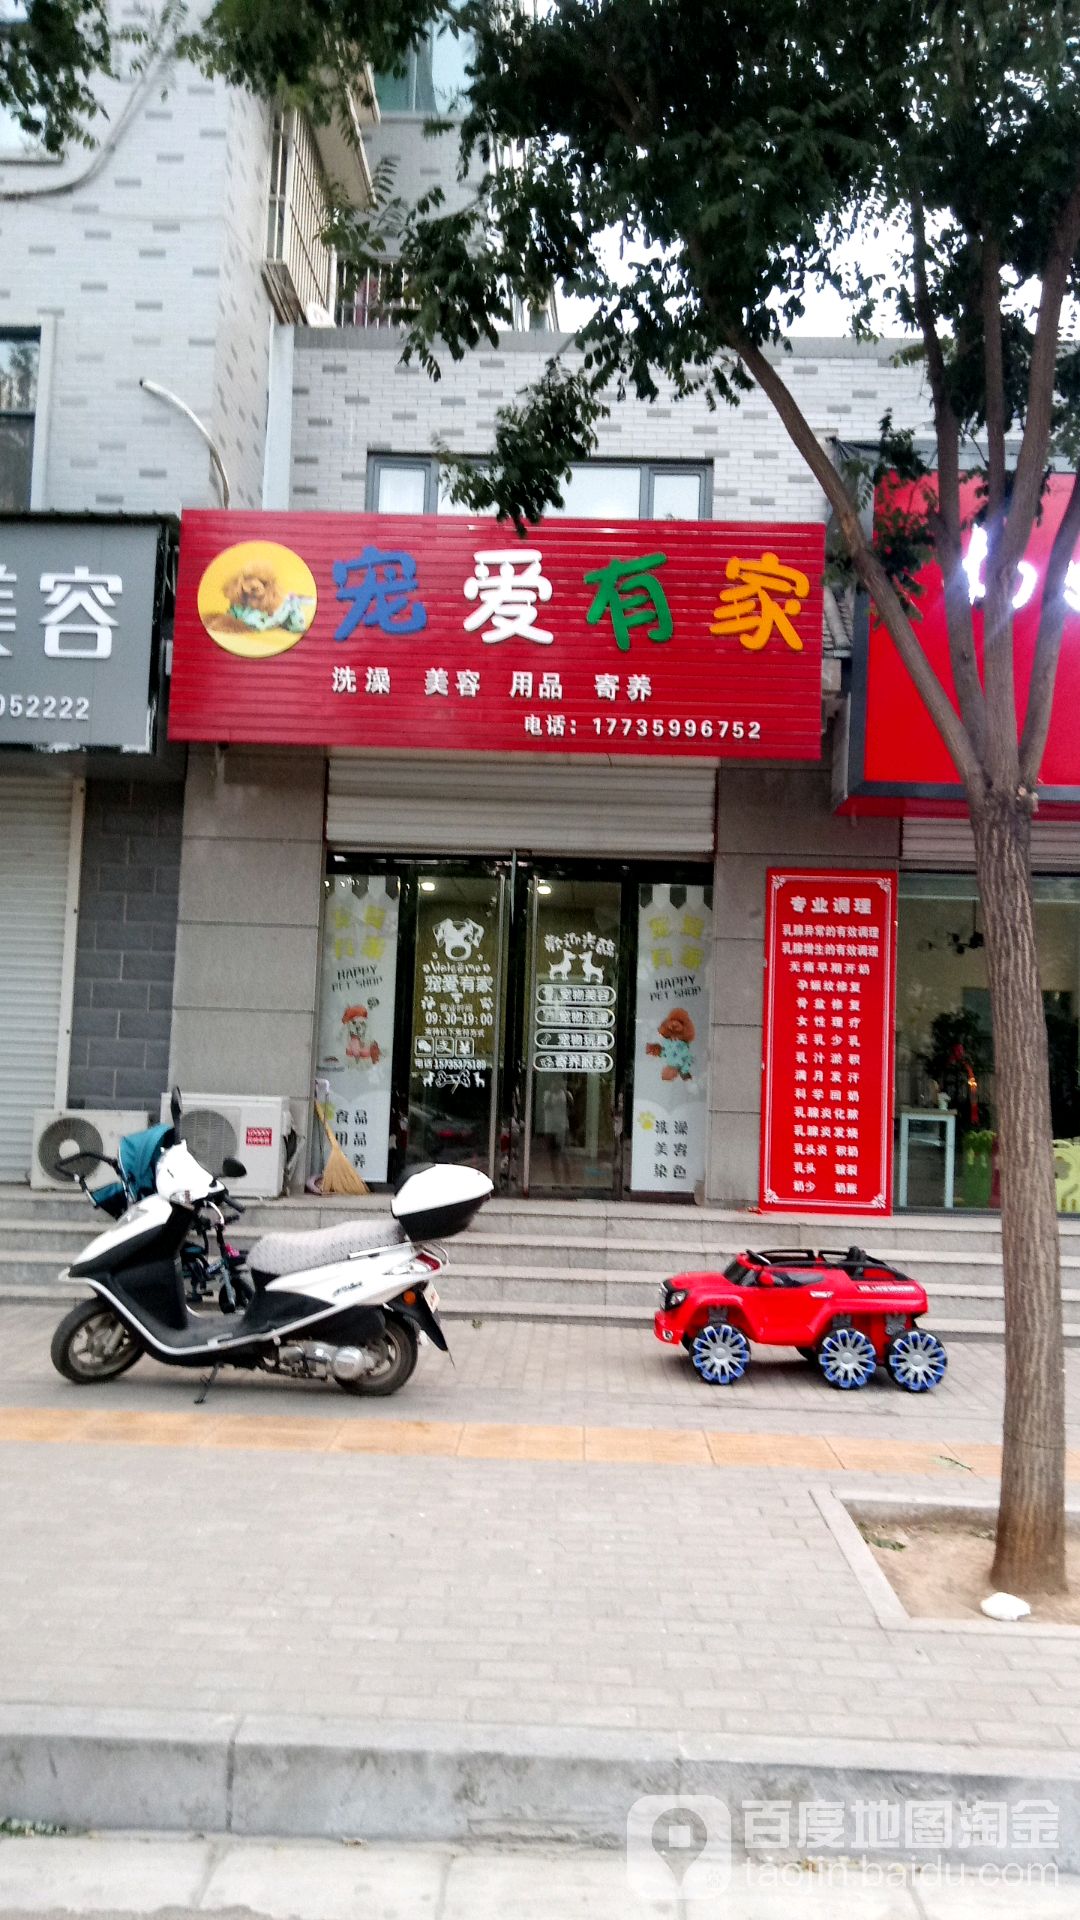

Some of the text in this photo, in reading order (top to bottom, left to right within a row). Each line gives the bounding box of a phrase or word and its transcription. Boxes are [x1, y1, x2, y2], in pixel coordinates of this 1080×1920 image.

[332, 545, 809, 651] 宠爱有家
[0, 564, 123, 659] 容
[332, 666, 652, 701] 洗澡 美容 用品 寄养
[790, 895, 872, 915] 专业调理
[336, 964, 378, 981] HAPPY
[654, 974, 697, 990] HAPPY
[796, 1015, 861, 1030] 女性理疗
[335, 1108, 368, 1125] 食品
